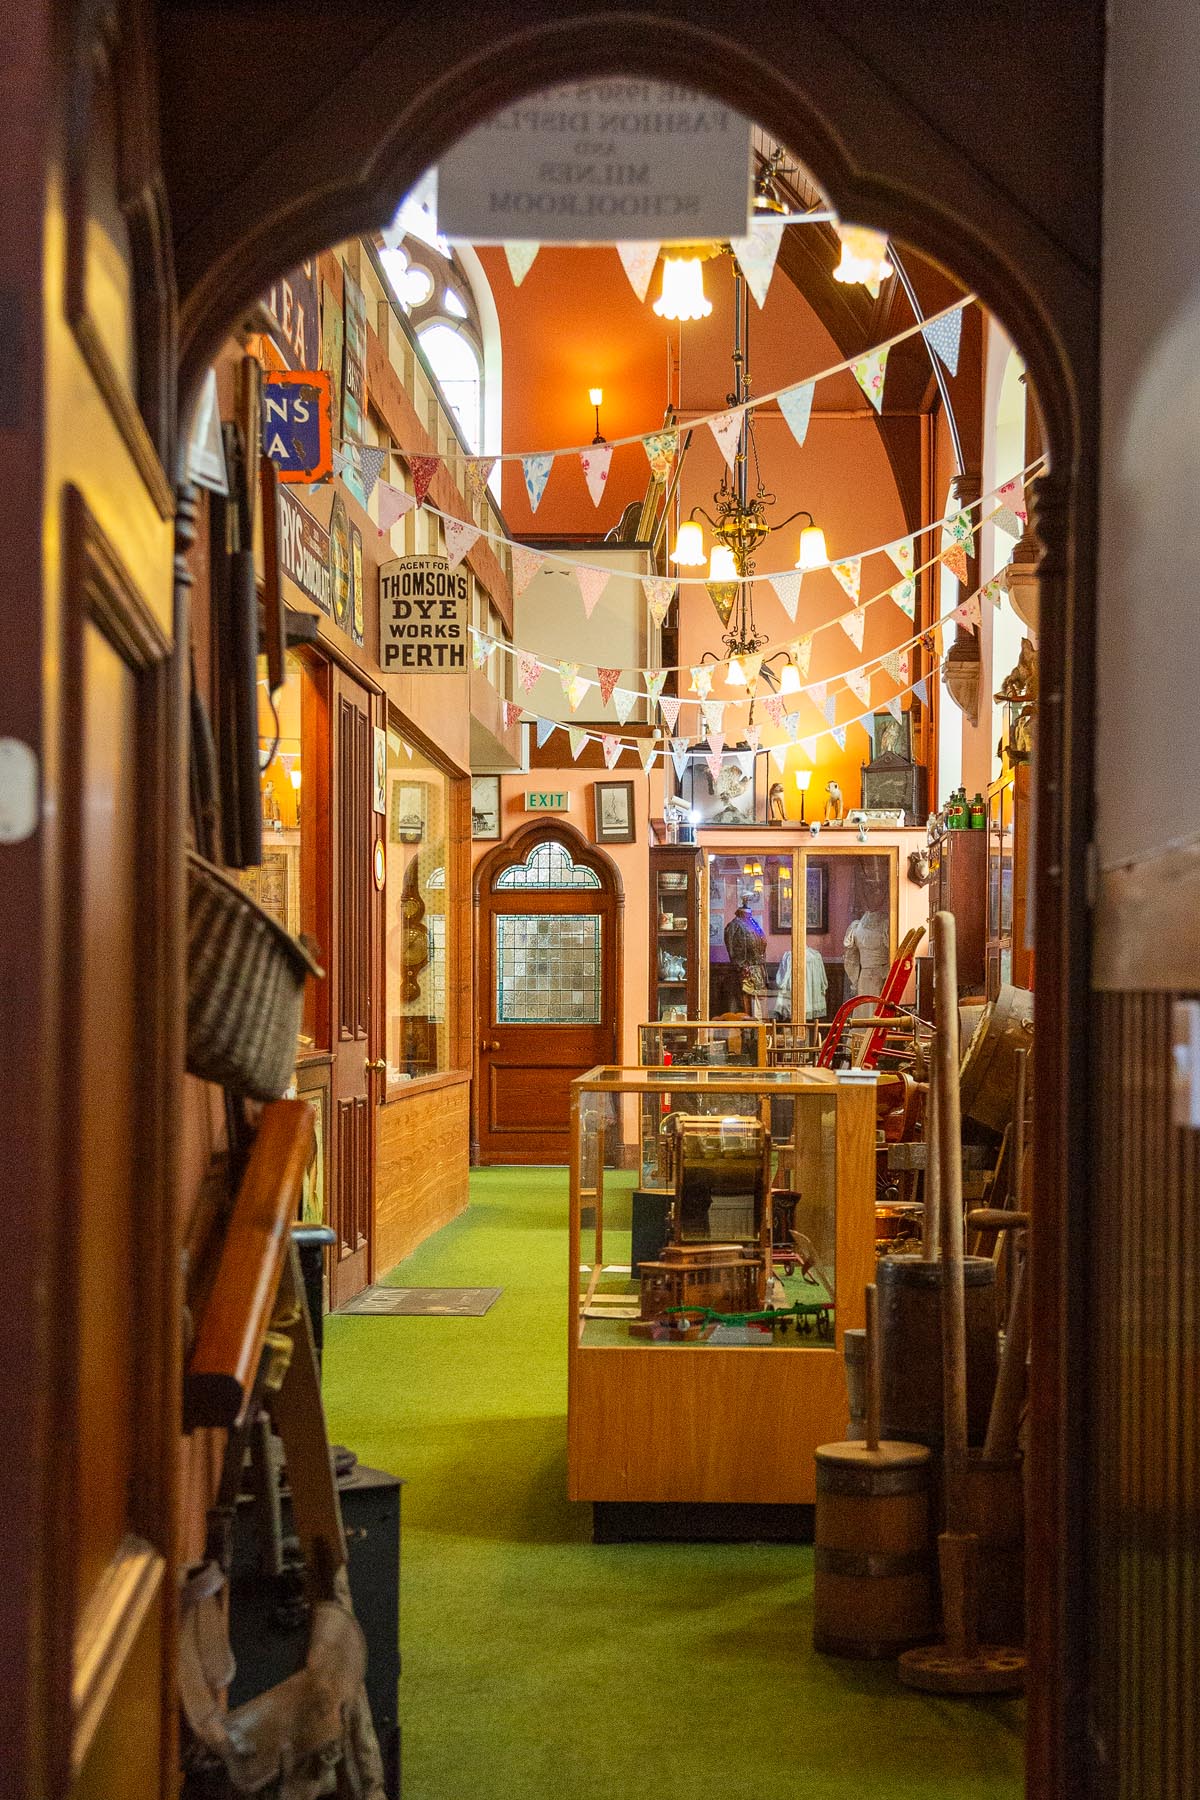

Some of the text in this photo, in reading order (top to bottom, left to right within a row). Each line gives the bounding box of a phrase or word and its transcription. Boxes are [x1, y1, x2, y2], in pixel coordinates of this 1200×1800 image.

[399, 561, 449, 571] AGENT FOR
[381, 572, 467, 600] THOMSON'S
[392, 600, 457, 619] DYE
[389, 624, 460, 638] WORKS
[385, 643, 465, 667] PERTH
[530, 794, 564, 807] EXIT
